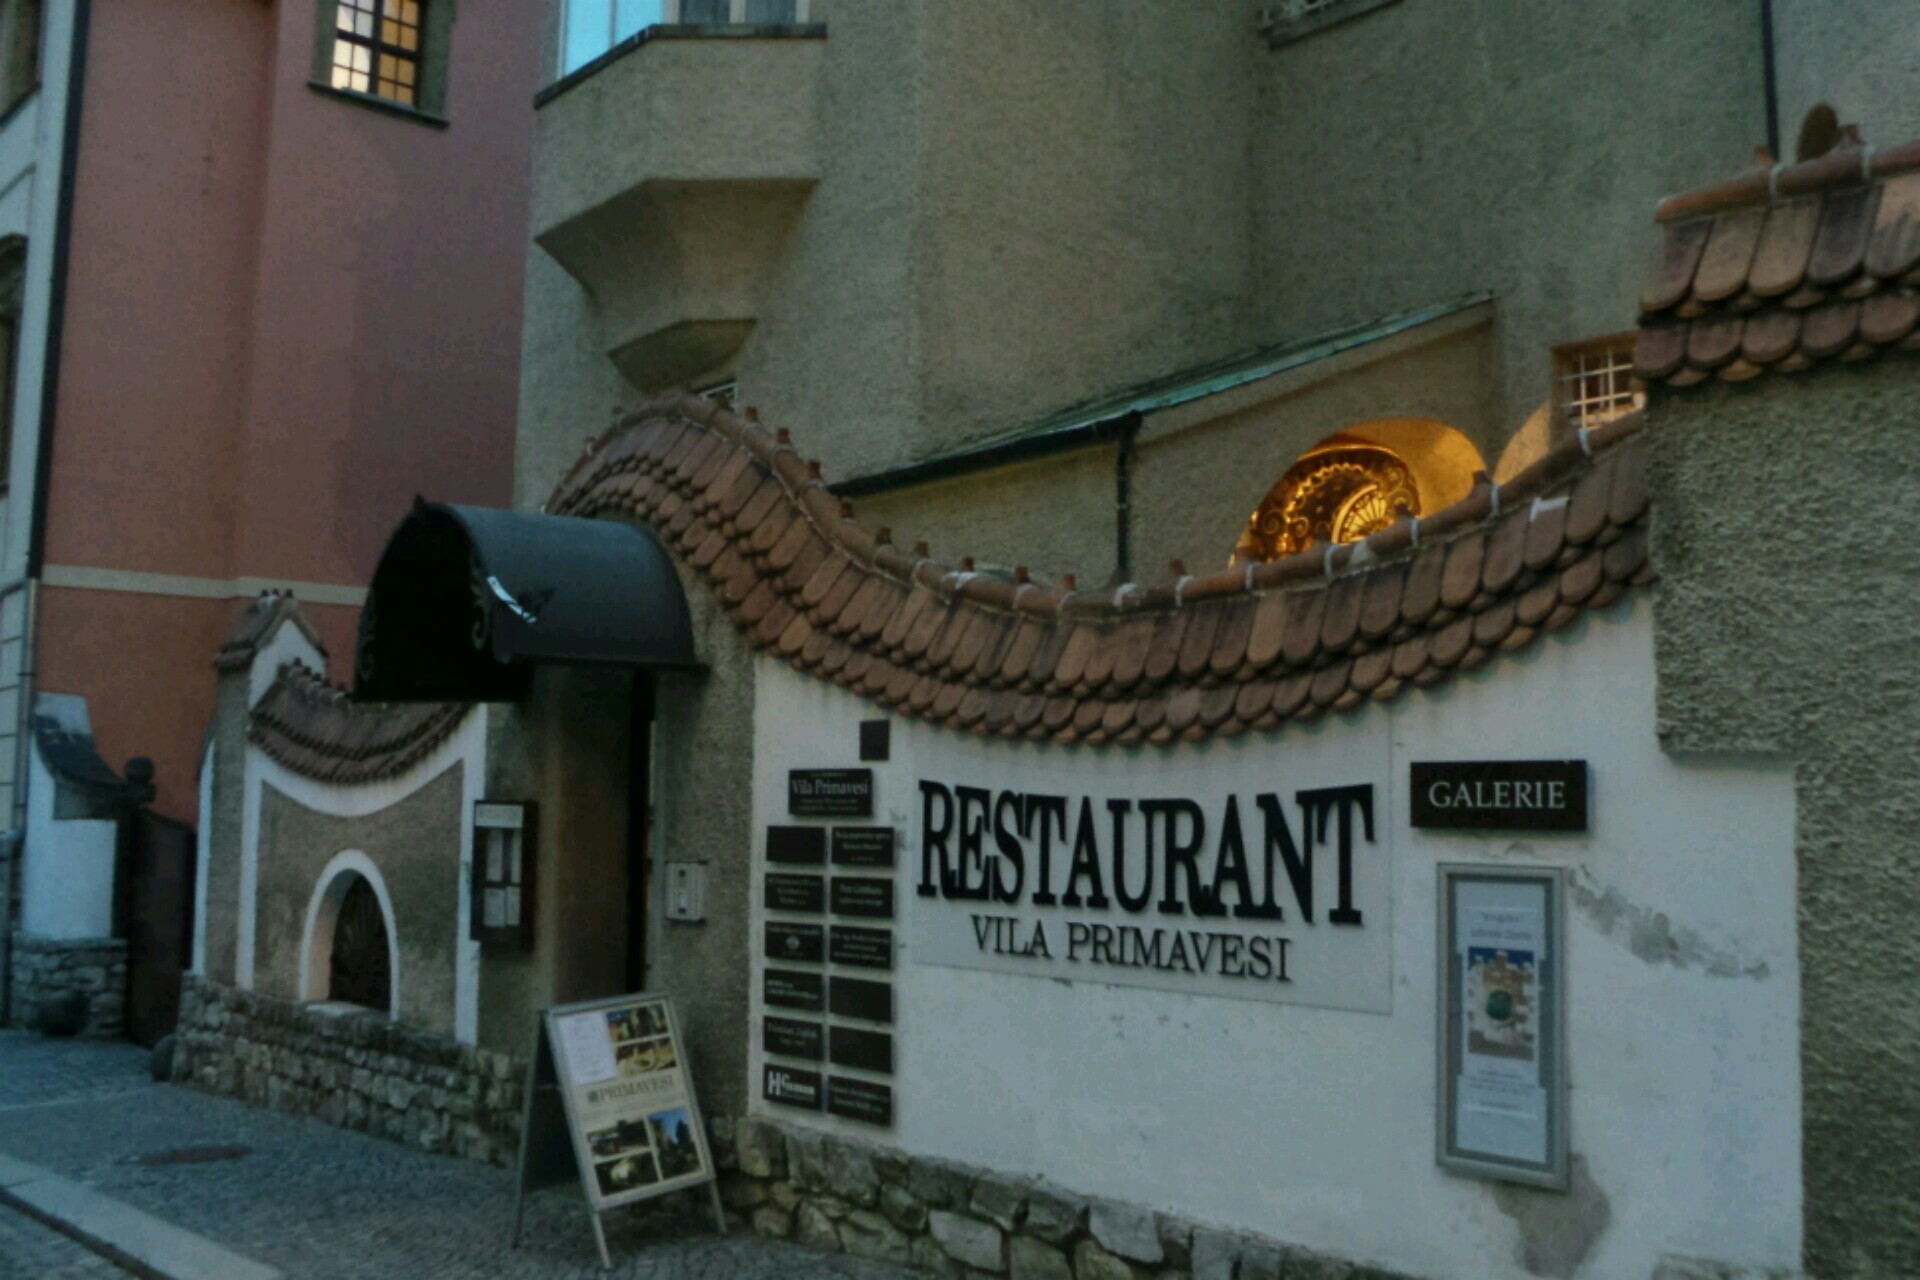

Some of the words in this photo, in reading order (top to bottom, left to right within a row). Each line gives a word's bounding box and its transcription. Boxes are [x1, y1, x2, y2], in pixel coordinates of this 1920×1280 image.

[1428, 780, 1567, 809] GALERIE
[917, 779, 1376, 926] RESTAURANT
[970, 914, 1054, 959] VILA
[1066, 922, 1293, 983] PRIMAVESI
[599, 1073, 675, 1101] PRIMAVESI
